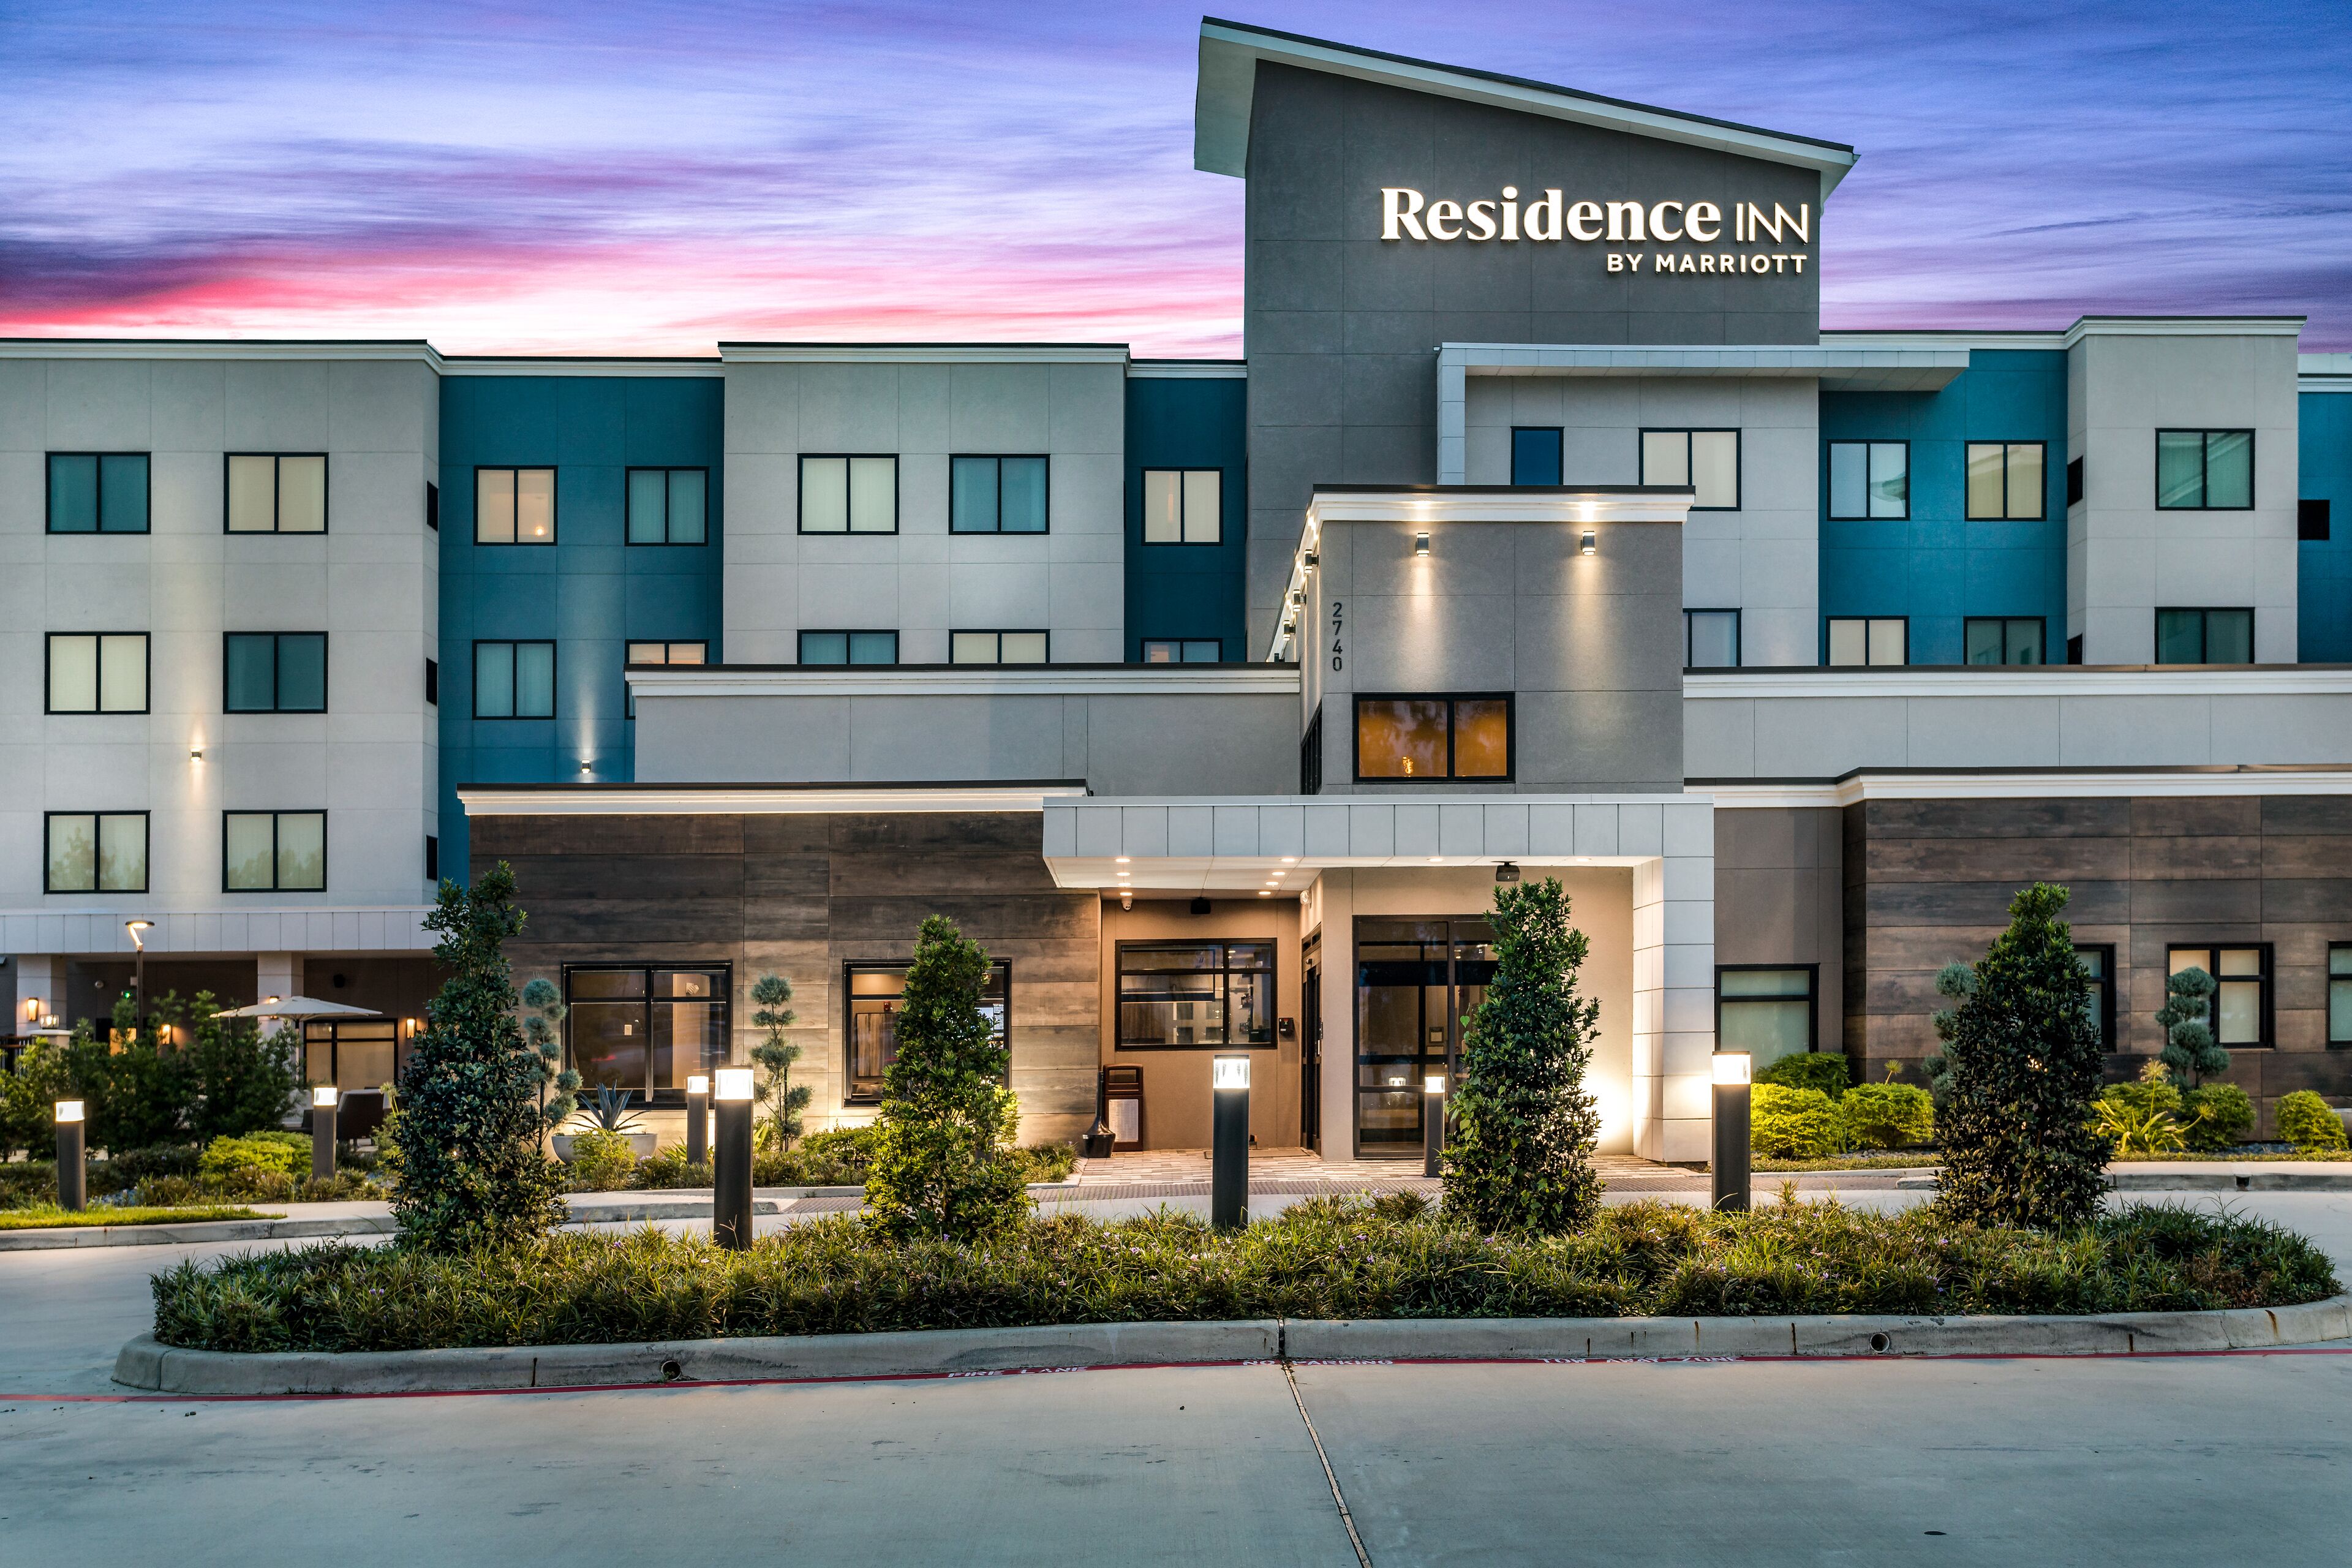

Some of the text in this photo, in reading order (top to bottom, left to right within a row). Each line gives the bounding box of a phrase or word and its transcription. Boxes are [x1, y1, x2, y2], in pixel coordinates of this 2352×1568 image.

[1380, 186, 1809, 243] Residence INN
[1607, 254, 1807, 273] BY MARRIOTT
[1332, 601, 1343, 672] 2740
